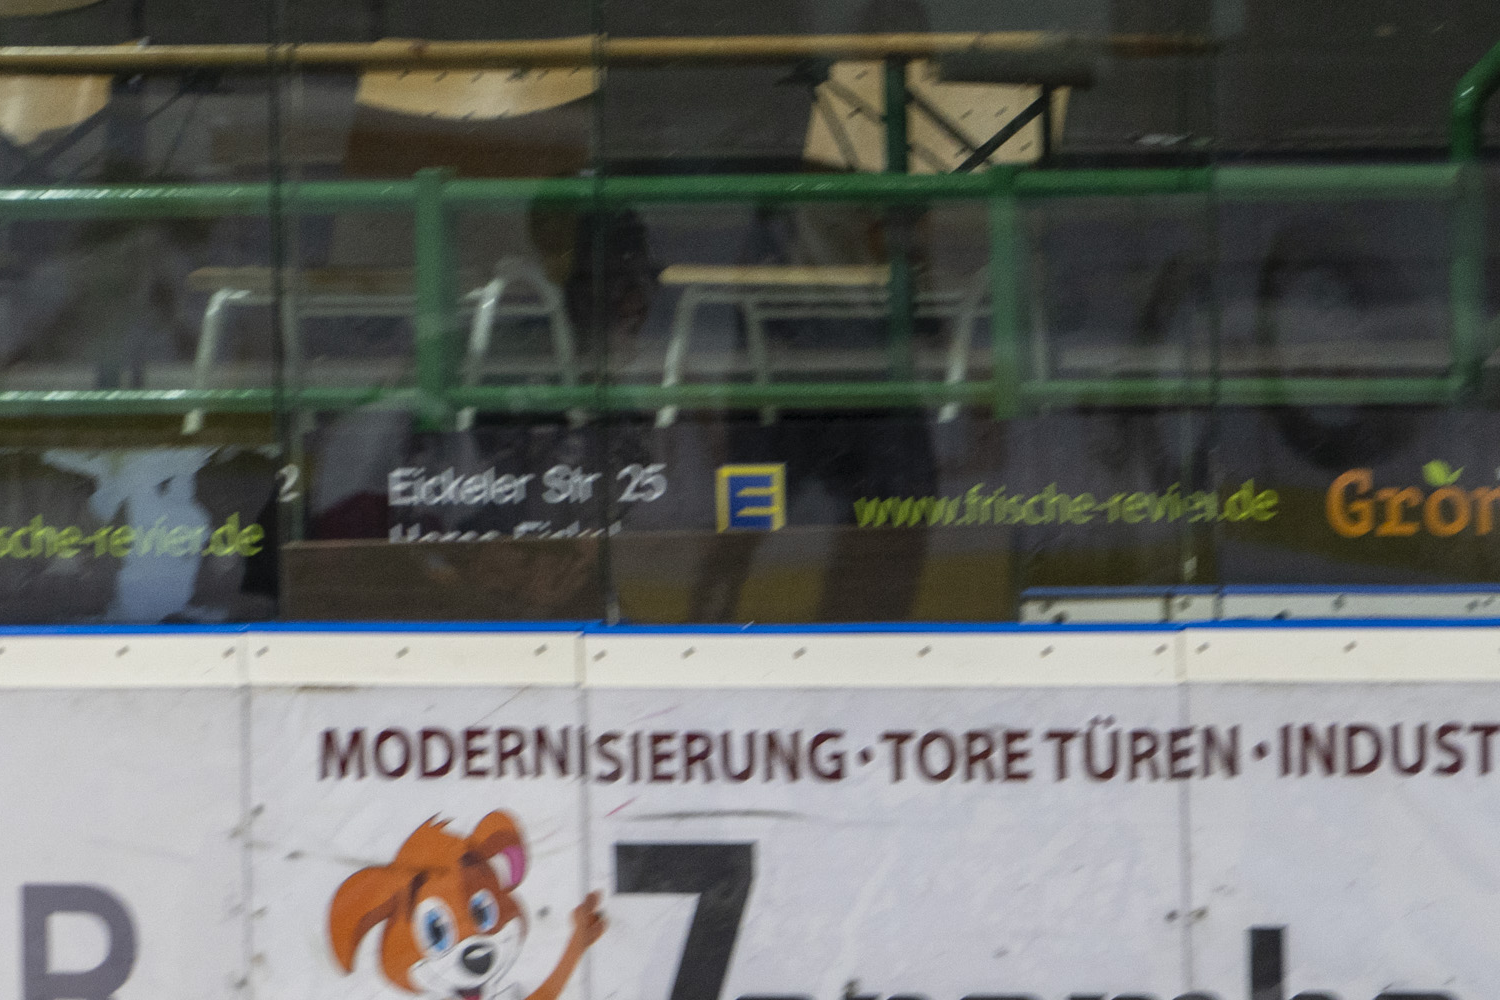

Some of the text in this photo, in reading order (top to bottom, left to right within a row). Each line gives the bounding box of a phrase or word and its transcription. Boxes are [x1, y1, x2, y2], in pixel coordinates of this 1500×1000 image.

[388, 466, 534, 506] Eickeler
[616, 463, 668, 503] 25
[318, 726, 847, 784] MODERNISIERUNG
[880, 728, 1034, 783] TORE
[1043, 716, 1242, 782] TÜREN
